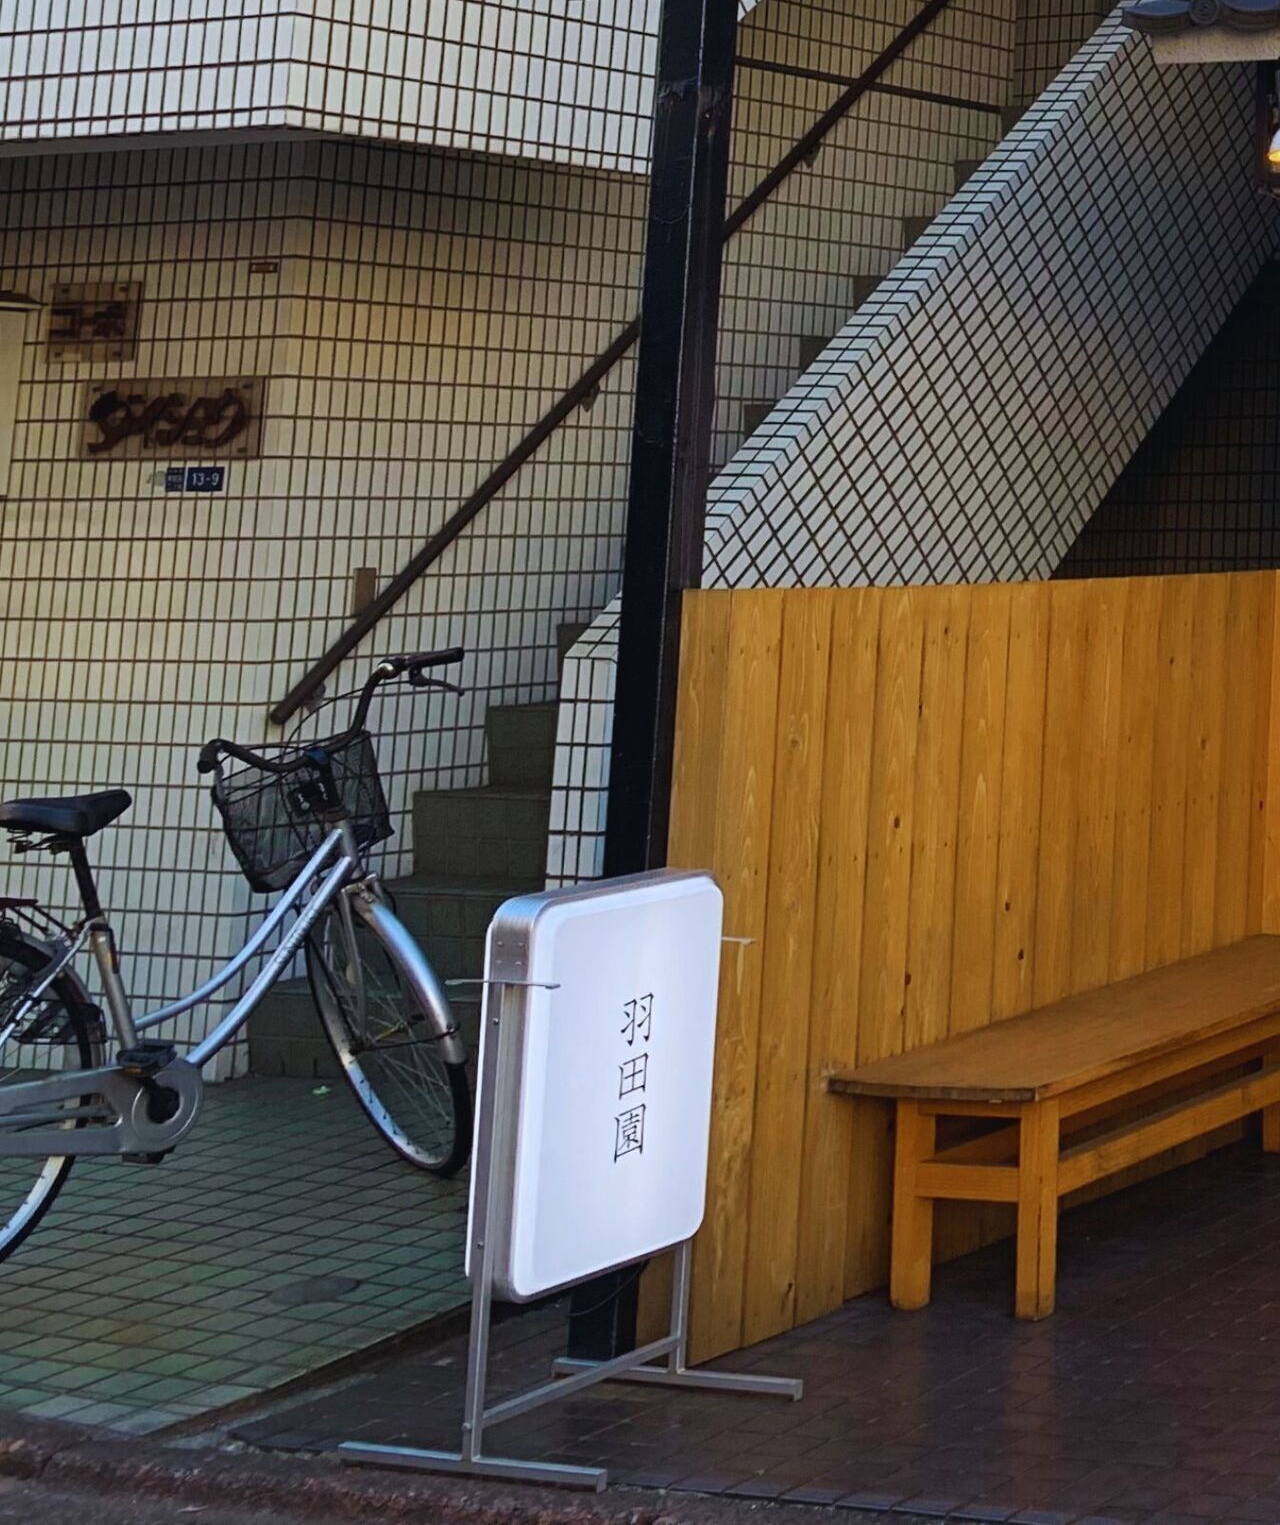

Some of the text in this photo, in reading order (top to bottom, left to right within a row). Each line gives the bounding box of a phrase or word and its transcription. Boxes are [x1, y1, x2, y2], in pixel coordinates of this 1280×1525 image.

[192, 472, 219, 486] 13-9
[613, 992, 655, 1164] 羽田園
